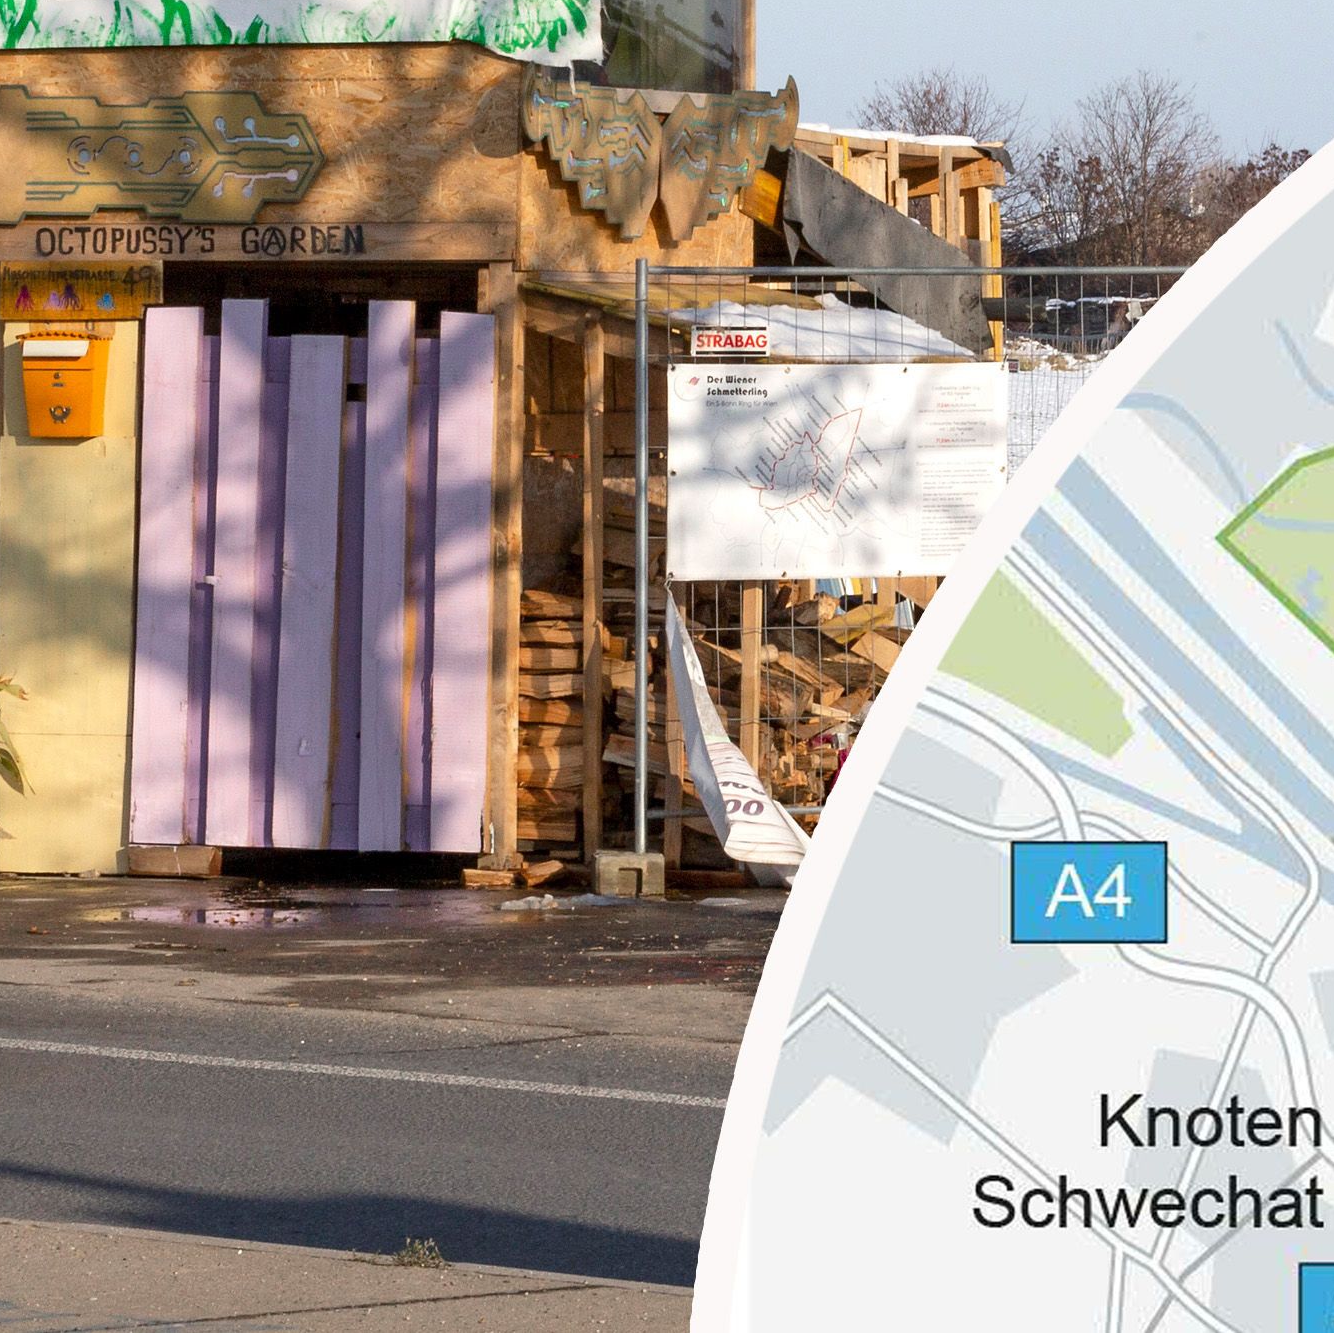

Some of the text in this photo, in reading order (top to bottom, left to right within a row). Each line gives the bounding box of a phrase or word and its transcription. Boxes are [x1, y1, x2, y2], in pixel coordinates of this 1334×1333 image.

[240, 225, 364, 257] GARDEN
[696, 333, 768, 348] STRABAG
[707, 375, 757, 384] Der Wiener
[707, 387, 768, 399] Schmetterling
